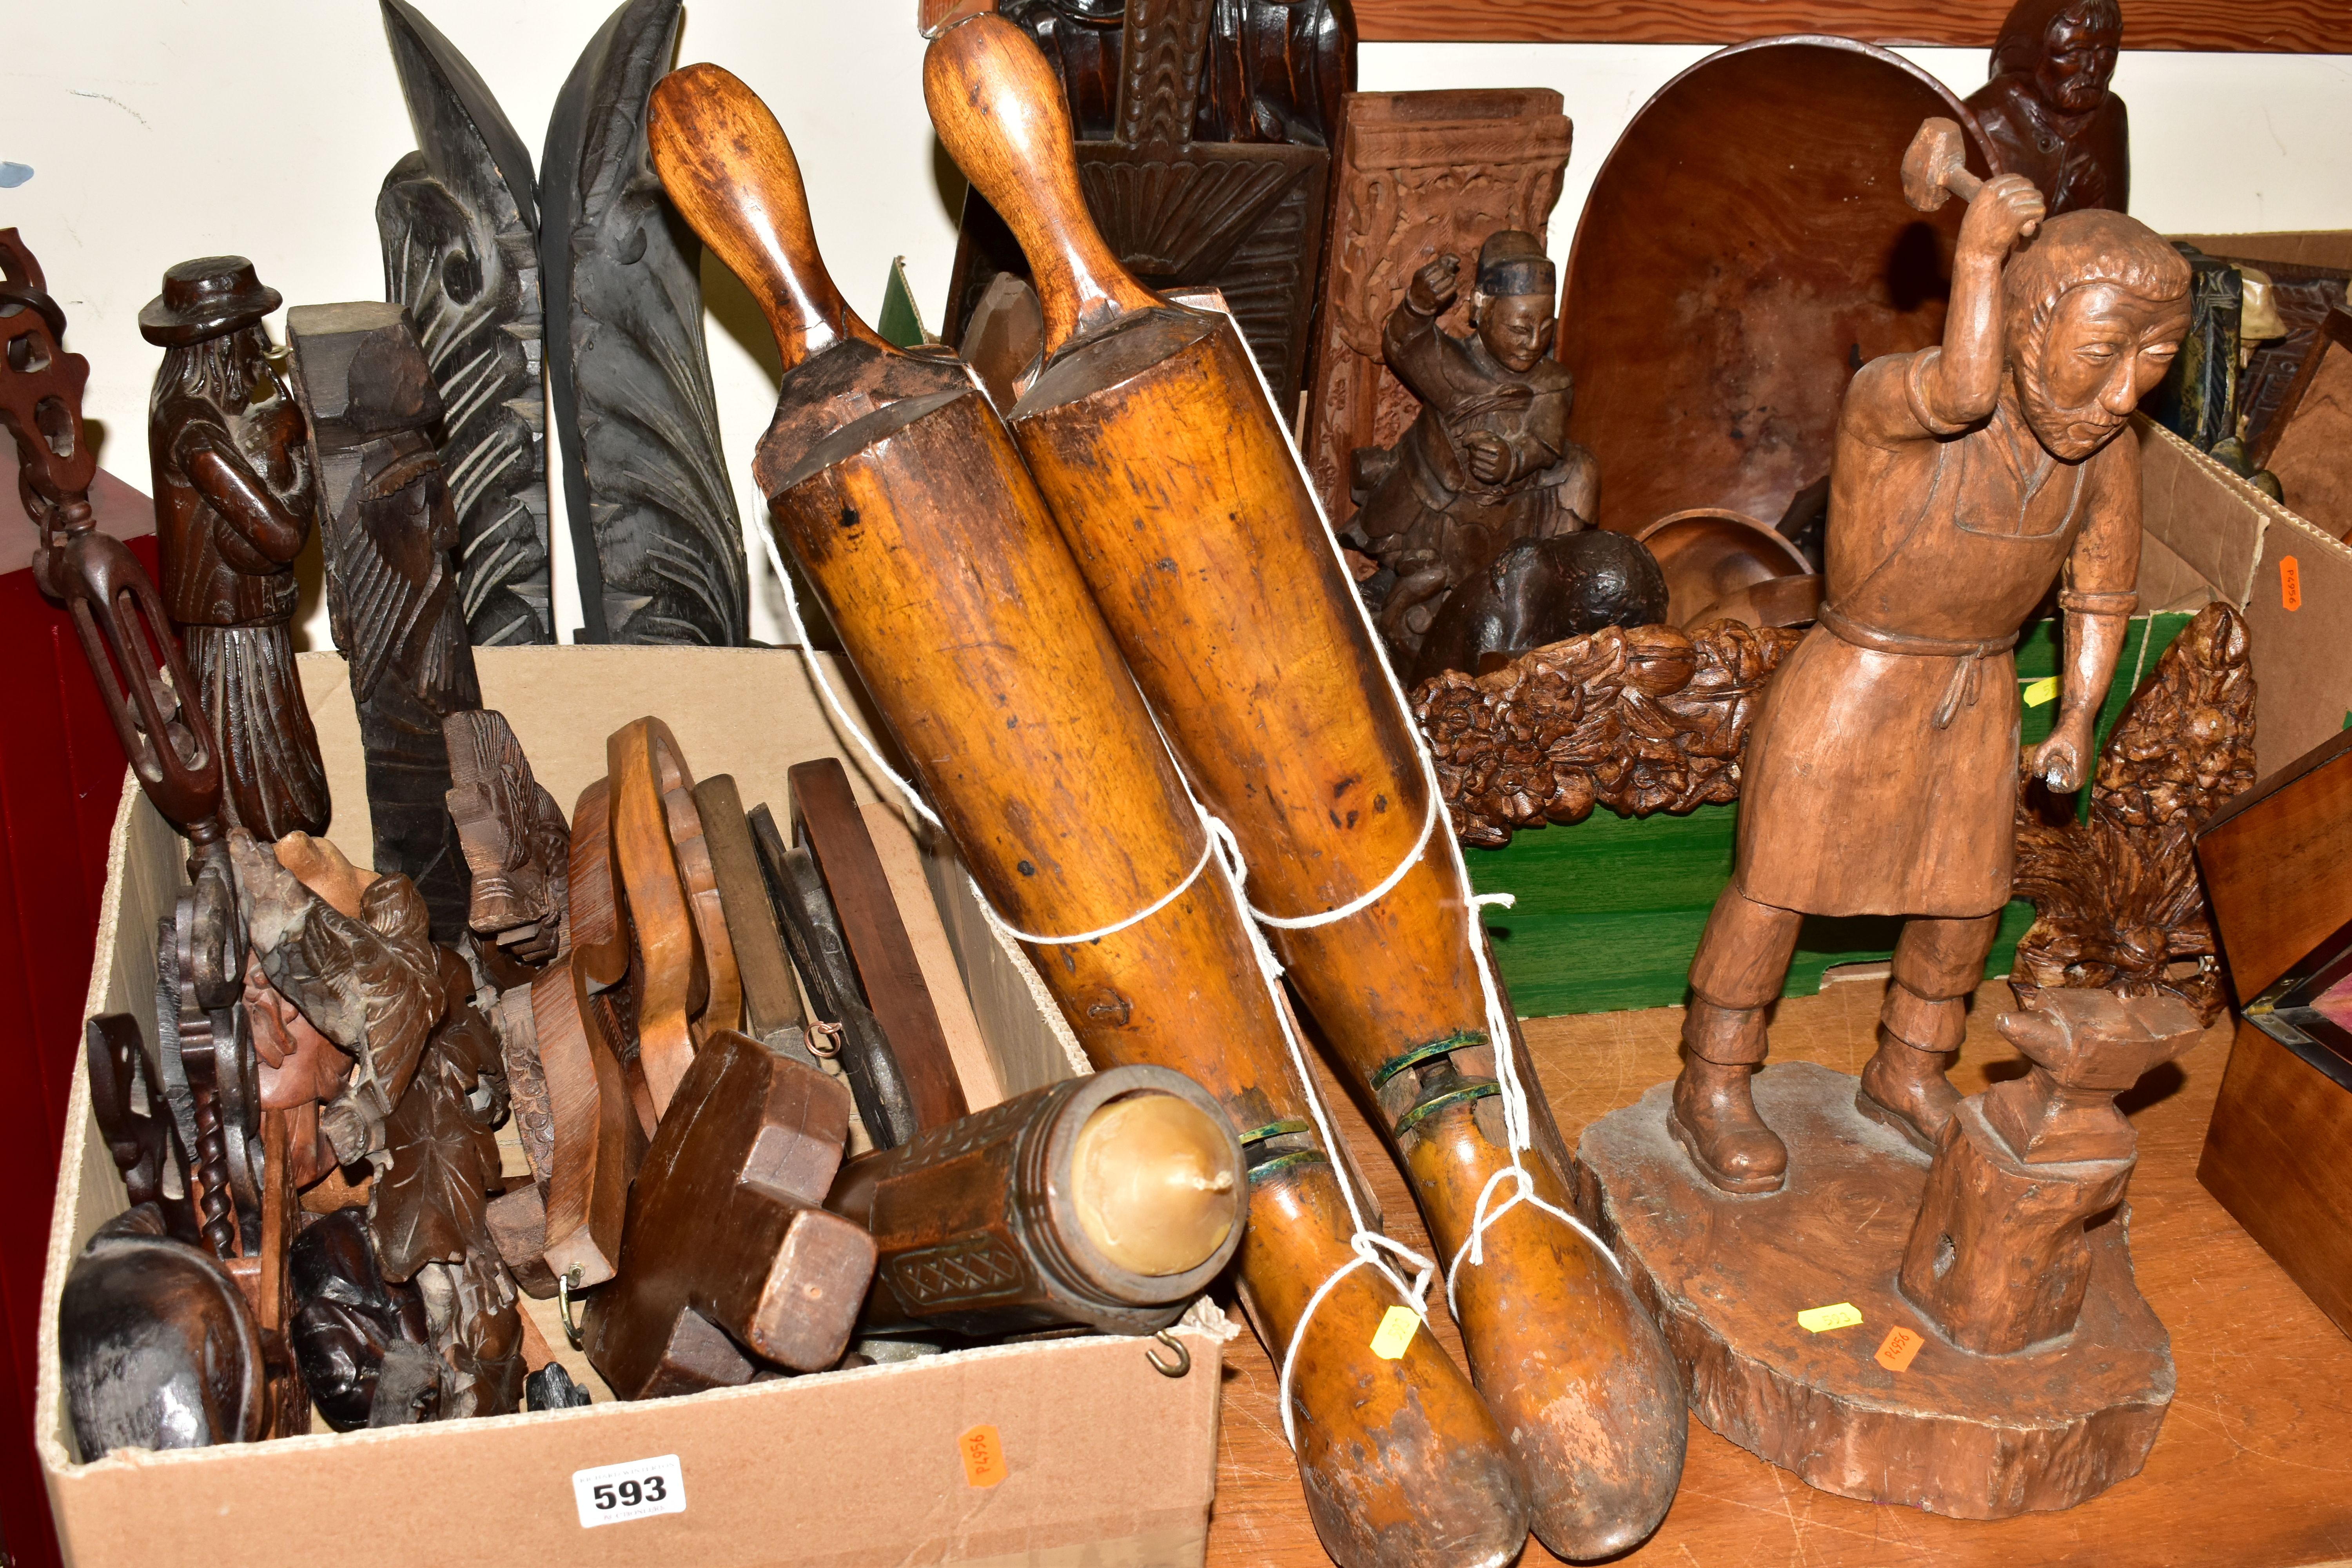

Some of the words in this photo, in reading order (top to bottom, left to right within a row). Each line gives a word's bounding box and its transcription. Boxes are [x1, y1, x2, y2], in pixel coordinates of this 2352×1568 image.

[2287, 570, 2296, 604] P4956
[1388, 1318, 1410, 1340] 593
[1822, 1312, 1851, 1325] 593
[1885, 1332, 1909, 1359] P4956
[969, 1435, 991, 1474] P4956
[593, 1475, 667, 1510] 593
